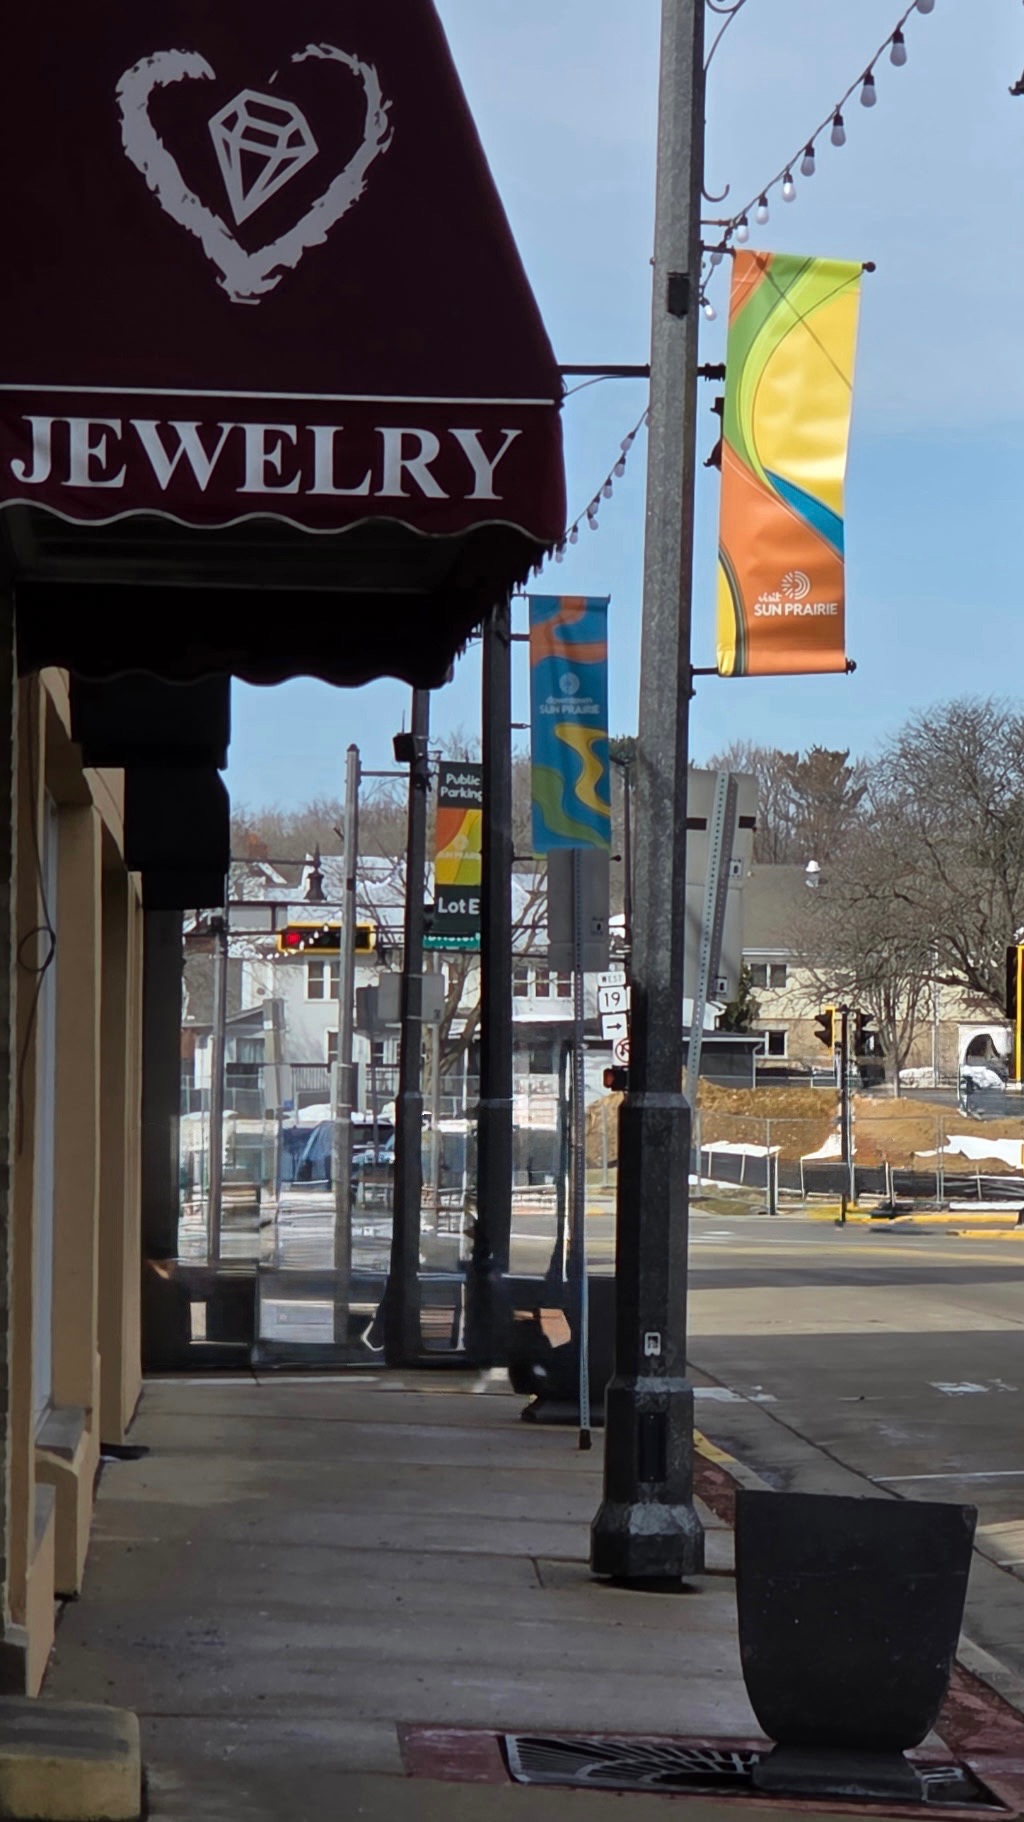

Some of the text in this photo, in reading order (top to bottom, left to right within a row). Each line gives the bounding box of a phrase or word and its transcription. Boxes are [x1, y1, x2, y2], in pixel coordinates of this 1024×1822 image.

[10, 415, 523, 500] JEWELRY
[757, 591, 783, 603] visit
[754, 602, 838, 617] SUN PRAIRIE
[539, 704, 600, 714] SUN PRAIRIE
[446, 773, 480, 787] Public
[438, 897, 480, 915] Lot E
[601, 975, 623, 984] WEST
[604, 991, 621, 1008] 19
